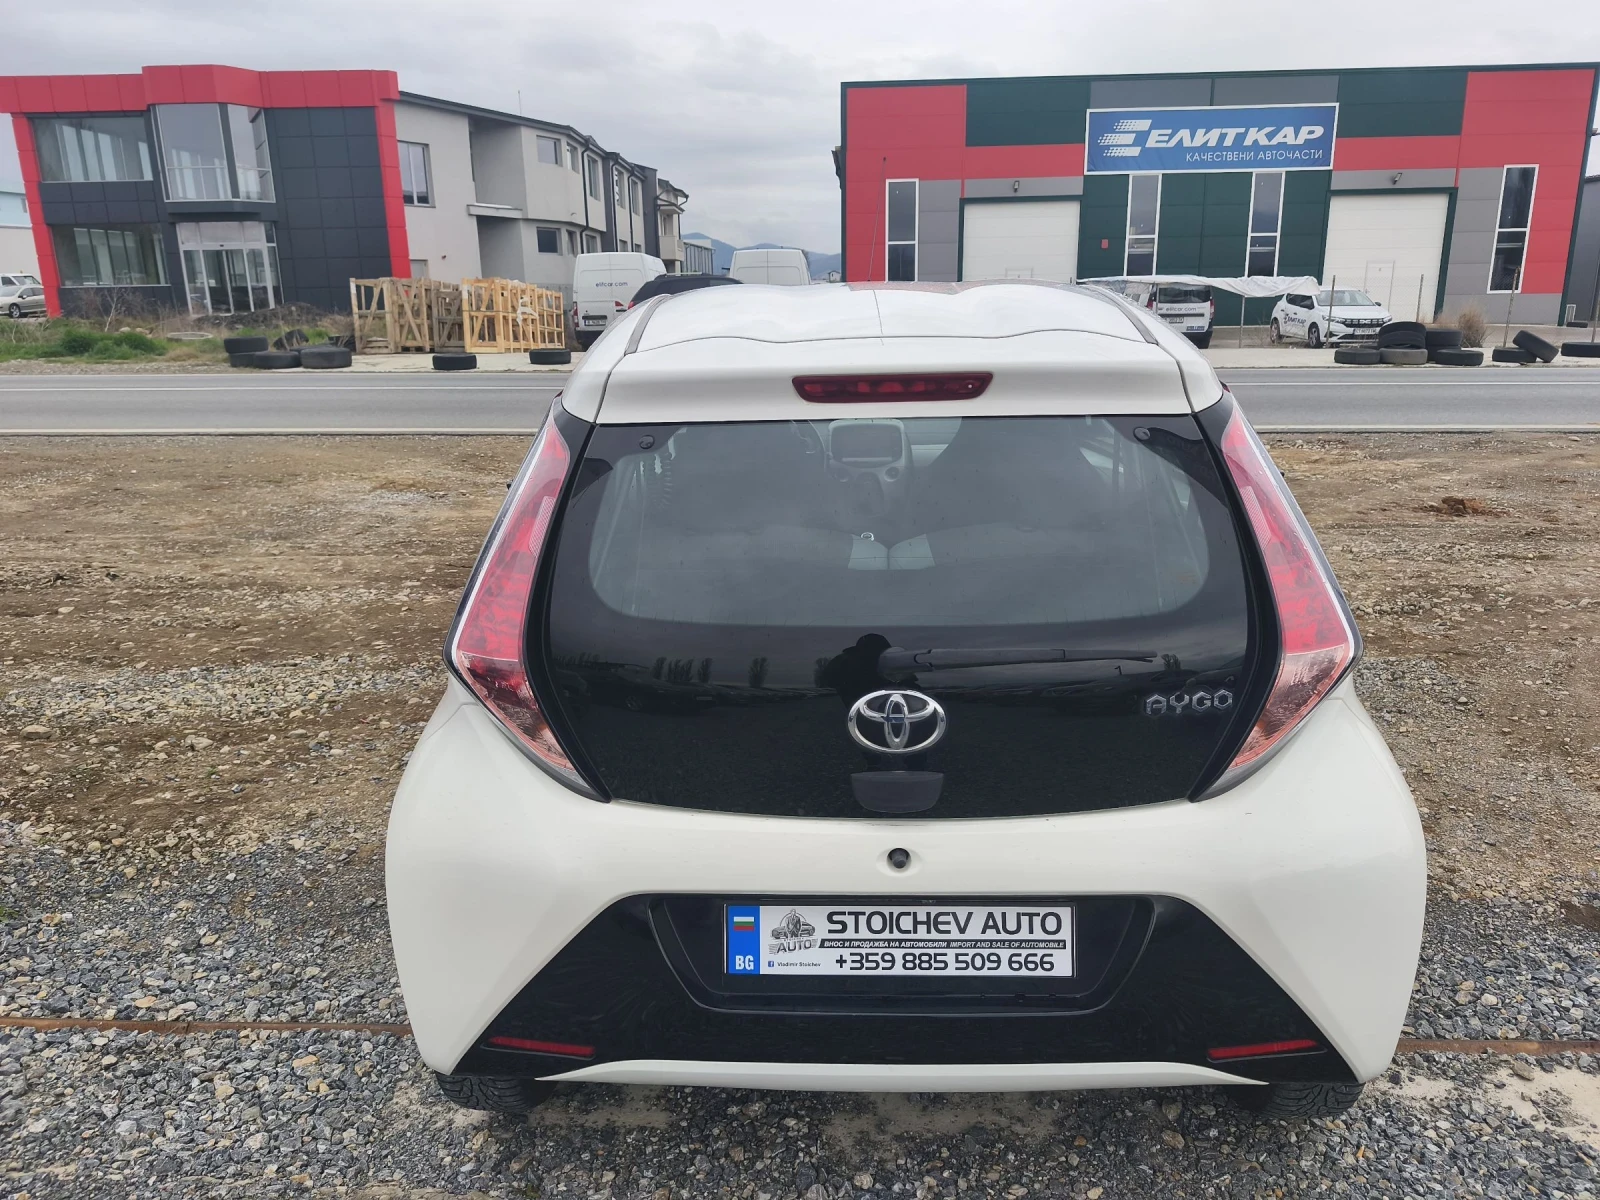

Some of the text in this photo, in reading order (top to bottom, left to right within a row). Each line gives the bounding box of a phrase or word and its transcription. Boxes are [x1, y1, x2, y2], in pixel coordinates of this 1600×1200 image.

[1186, 149, 1323, 163] КАЧЕСТВЕНИ АВТОЧАСТИ
[1145, 689, 1233, 715] AYGO
[826, 910, 1062, 936] STOICHEV AUTO
[776, 939, 812, 954] AUTO
[824, 940, 845, 948] ВНОС
[850, 941, 889, 949] ПРОДАЖБА
[1020, 941, 1065, 949] AUTOMOBILE
[735, 955, 754, 971] BG
[835, 952, 1055, 972] +359 885 509 666
